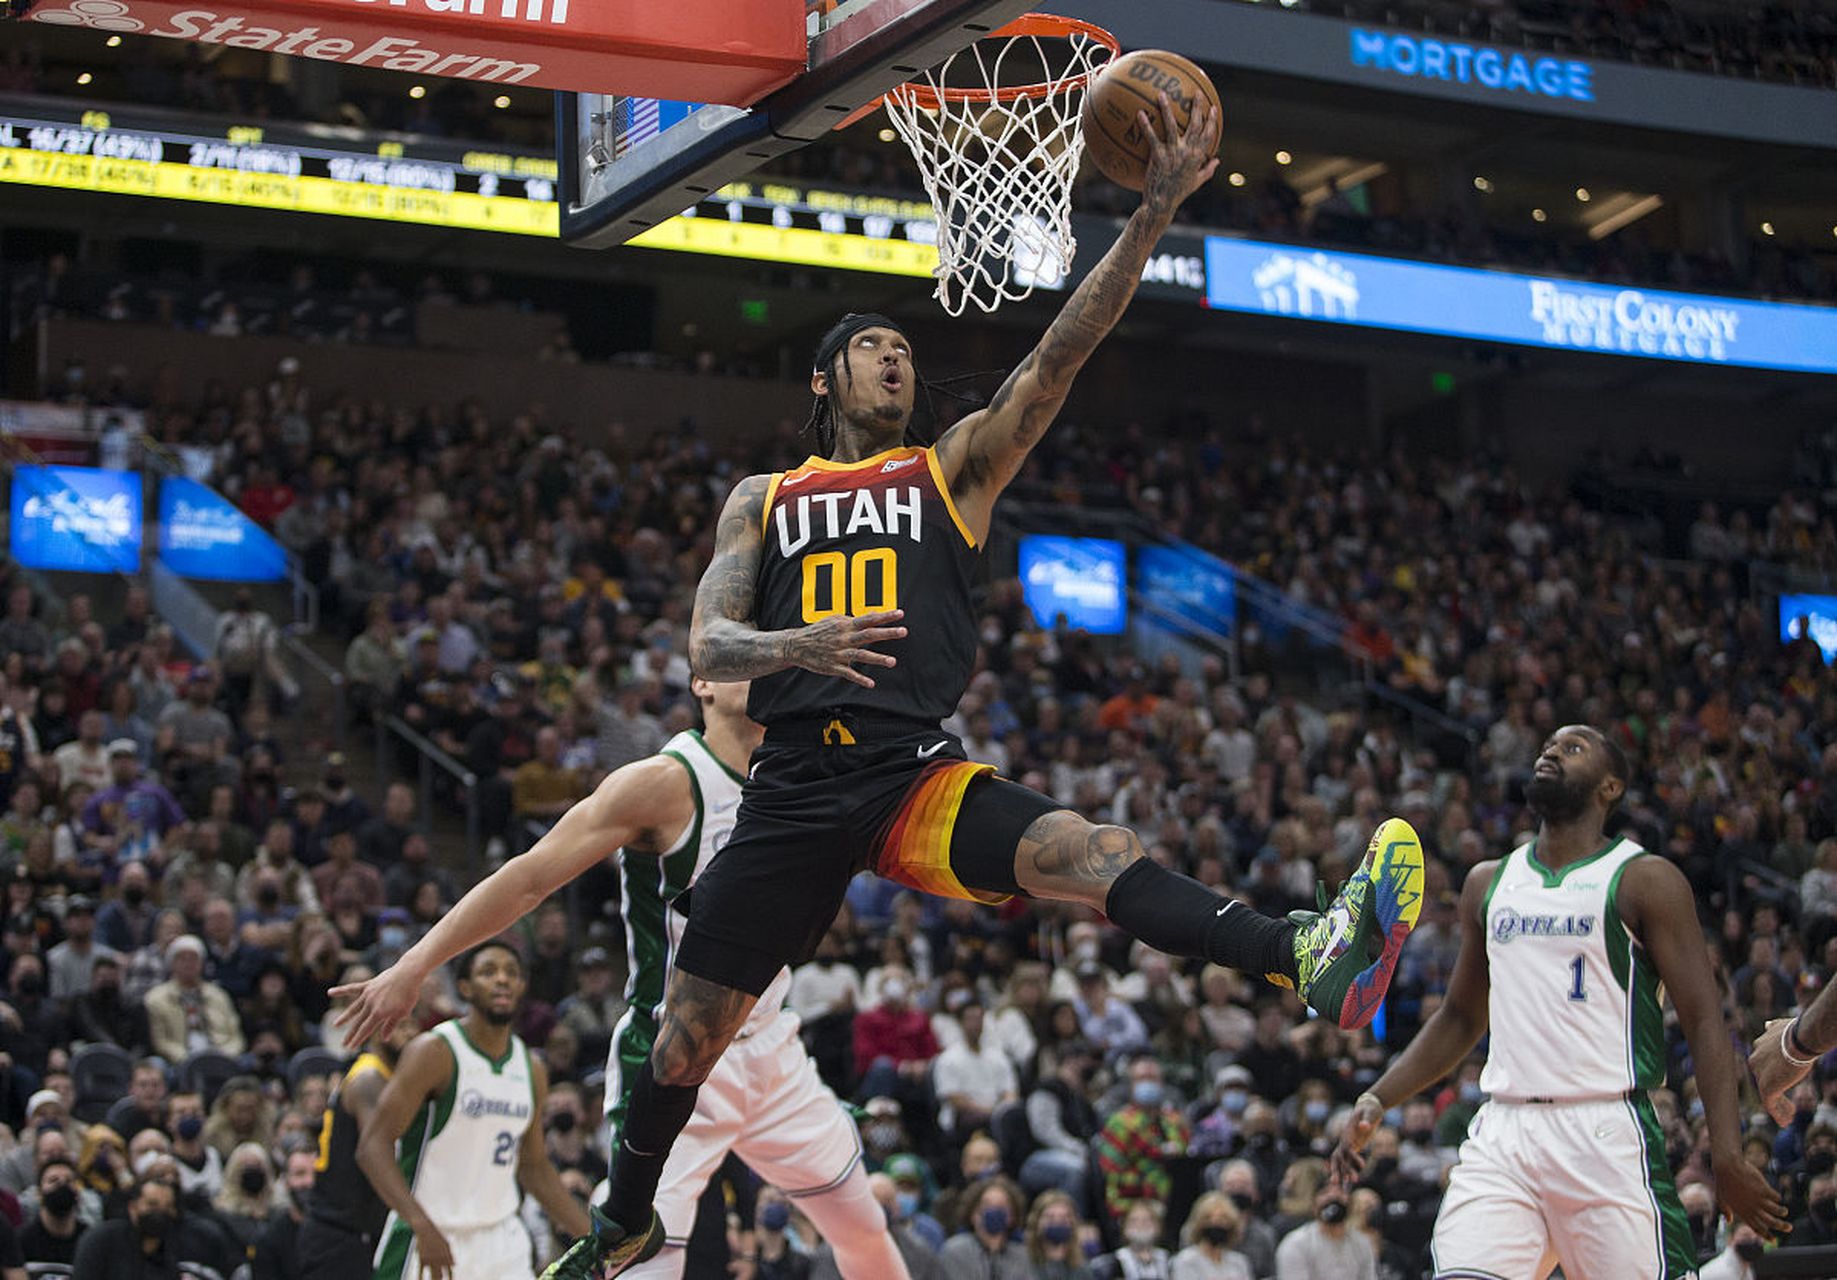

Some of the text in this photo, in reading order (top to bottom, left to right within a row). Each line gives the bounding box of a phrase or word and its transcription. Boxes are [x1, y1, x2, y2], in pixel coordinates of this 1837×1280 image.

[1350, 26, 1596, 101] MORTGAGE
[775, 486, 922, 558] UTAH
[801, 547, 898, 624] 00
[1567, 953, 1587, 1001] 1
